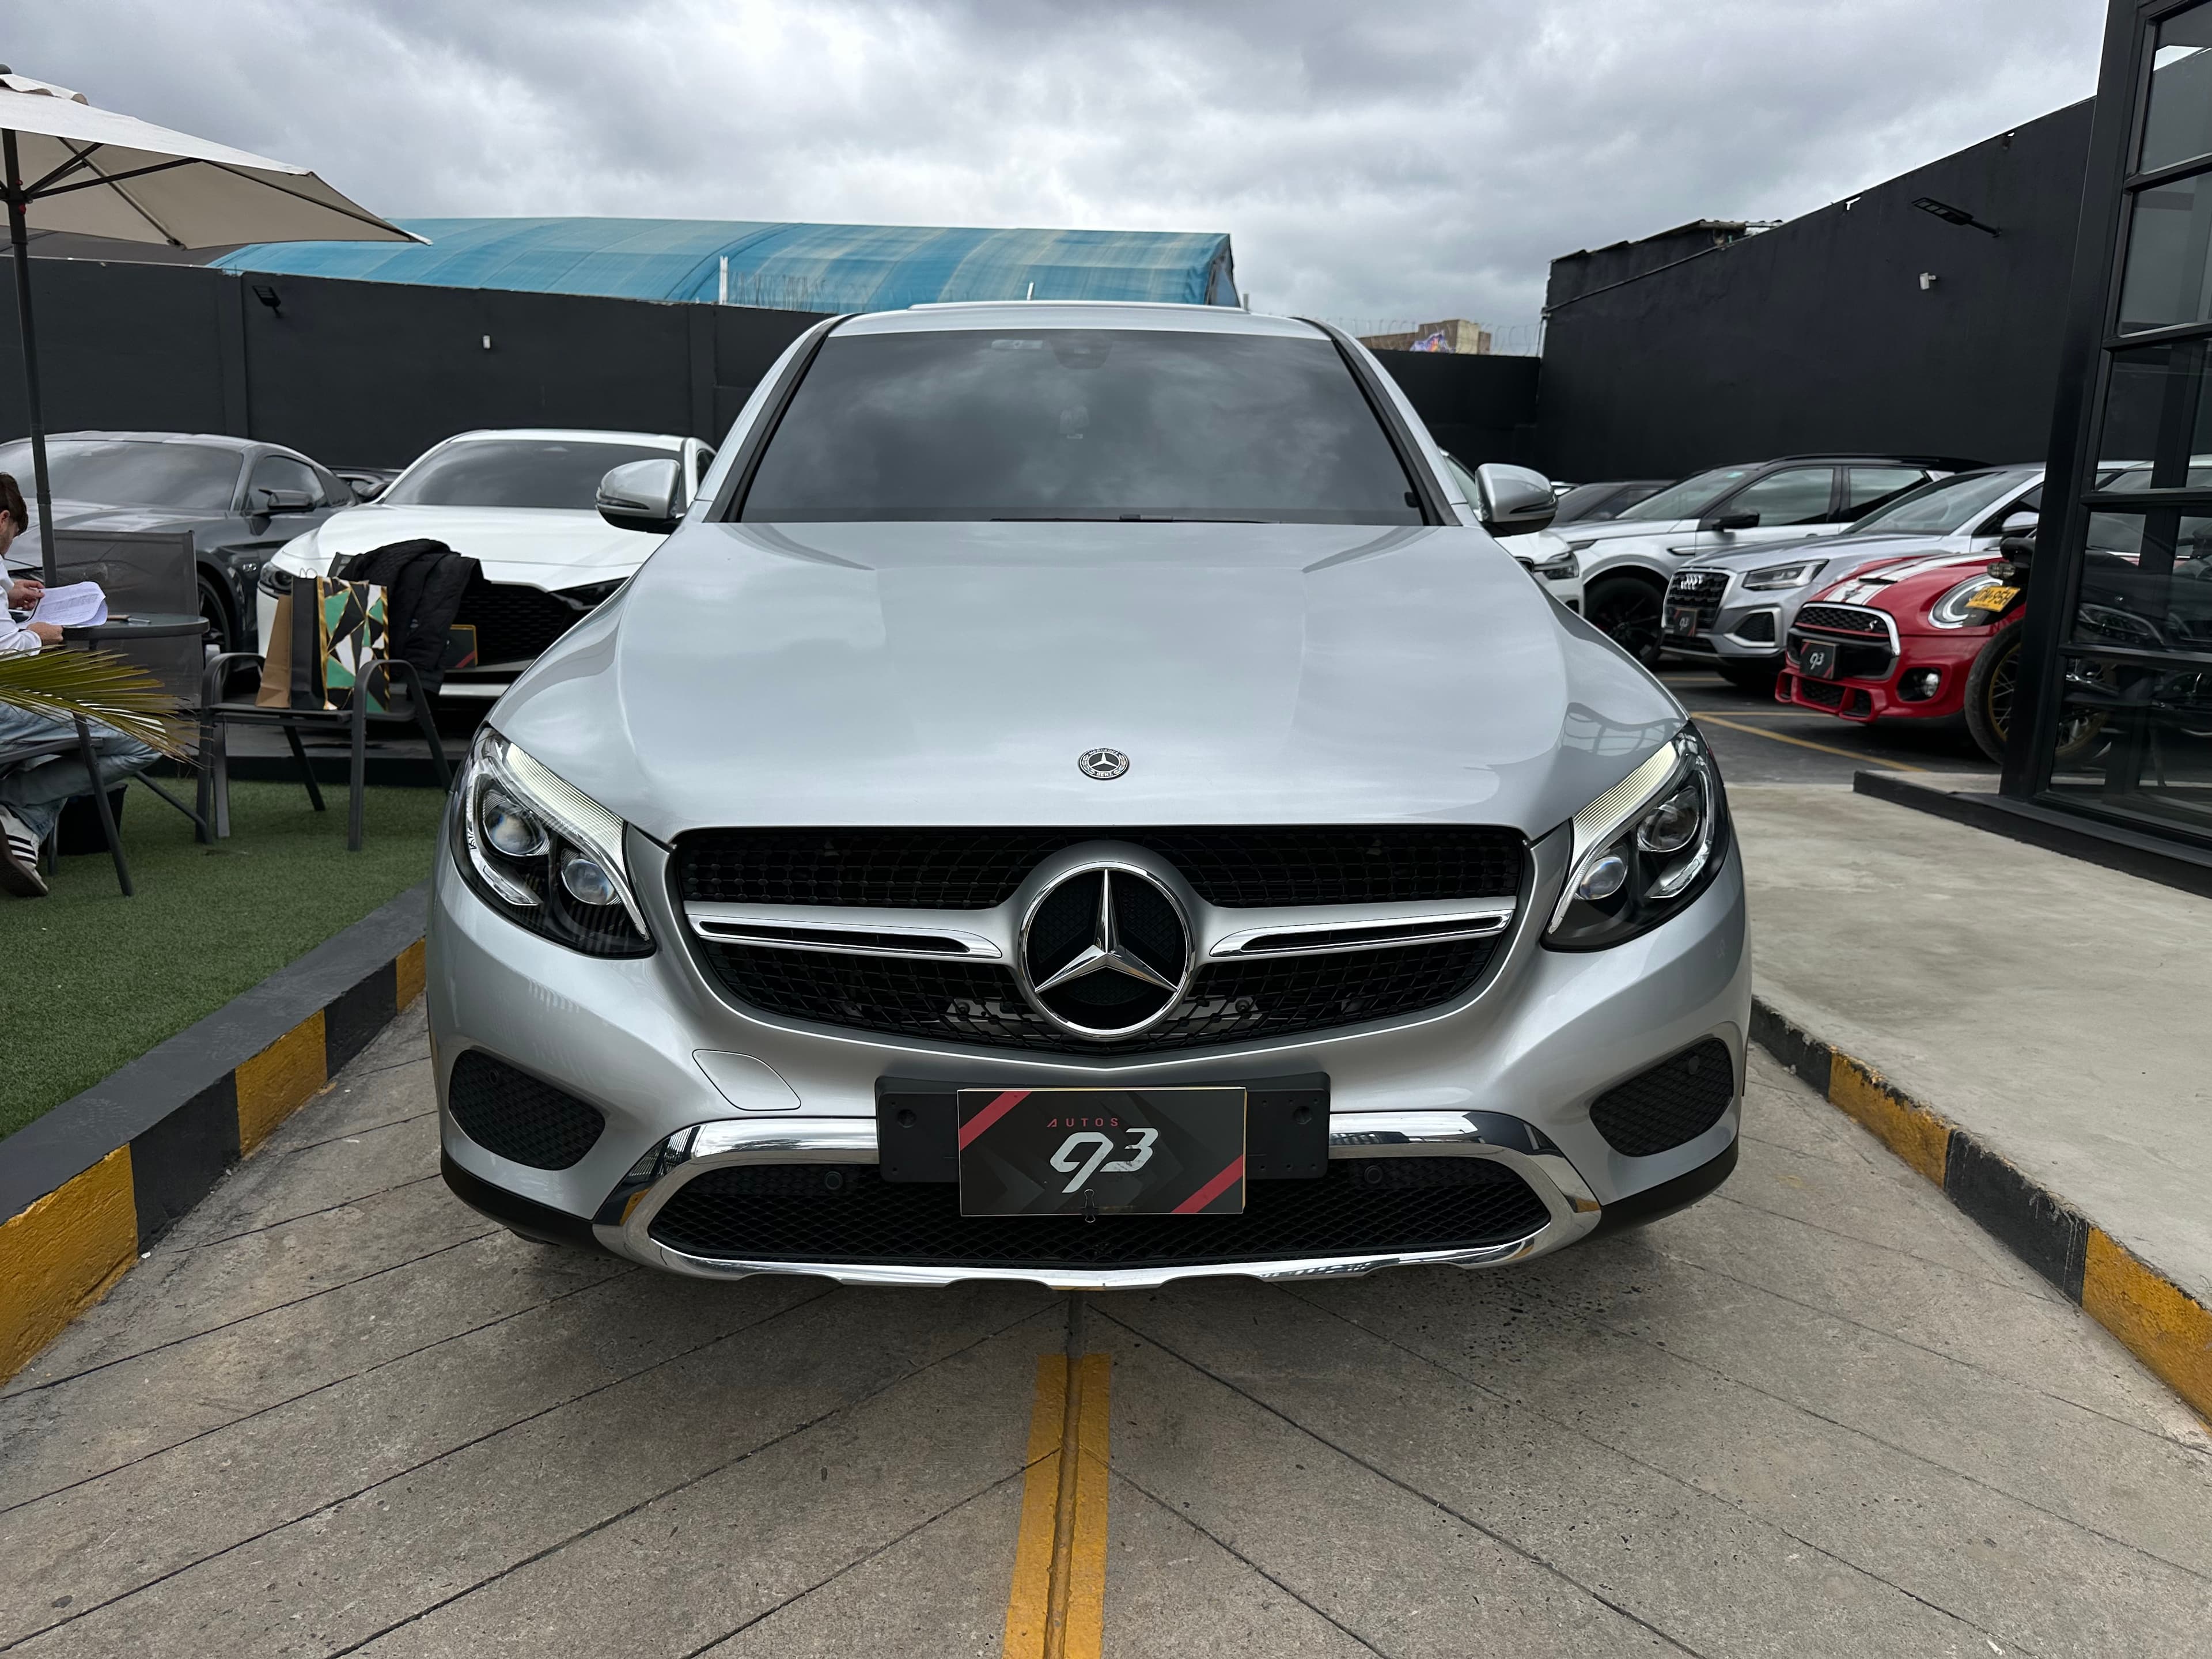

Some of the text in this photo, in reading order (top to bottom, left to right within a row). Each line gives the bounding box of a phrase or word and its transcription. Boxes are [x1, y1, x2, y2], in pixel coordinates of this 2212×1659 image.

[1809, 652, 1825, 670] 93
[1047, 1118, 1119, 1127] AUTOS
[1050, 1128, 1159, 1194] 93
